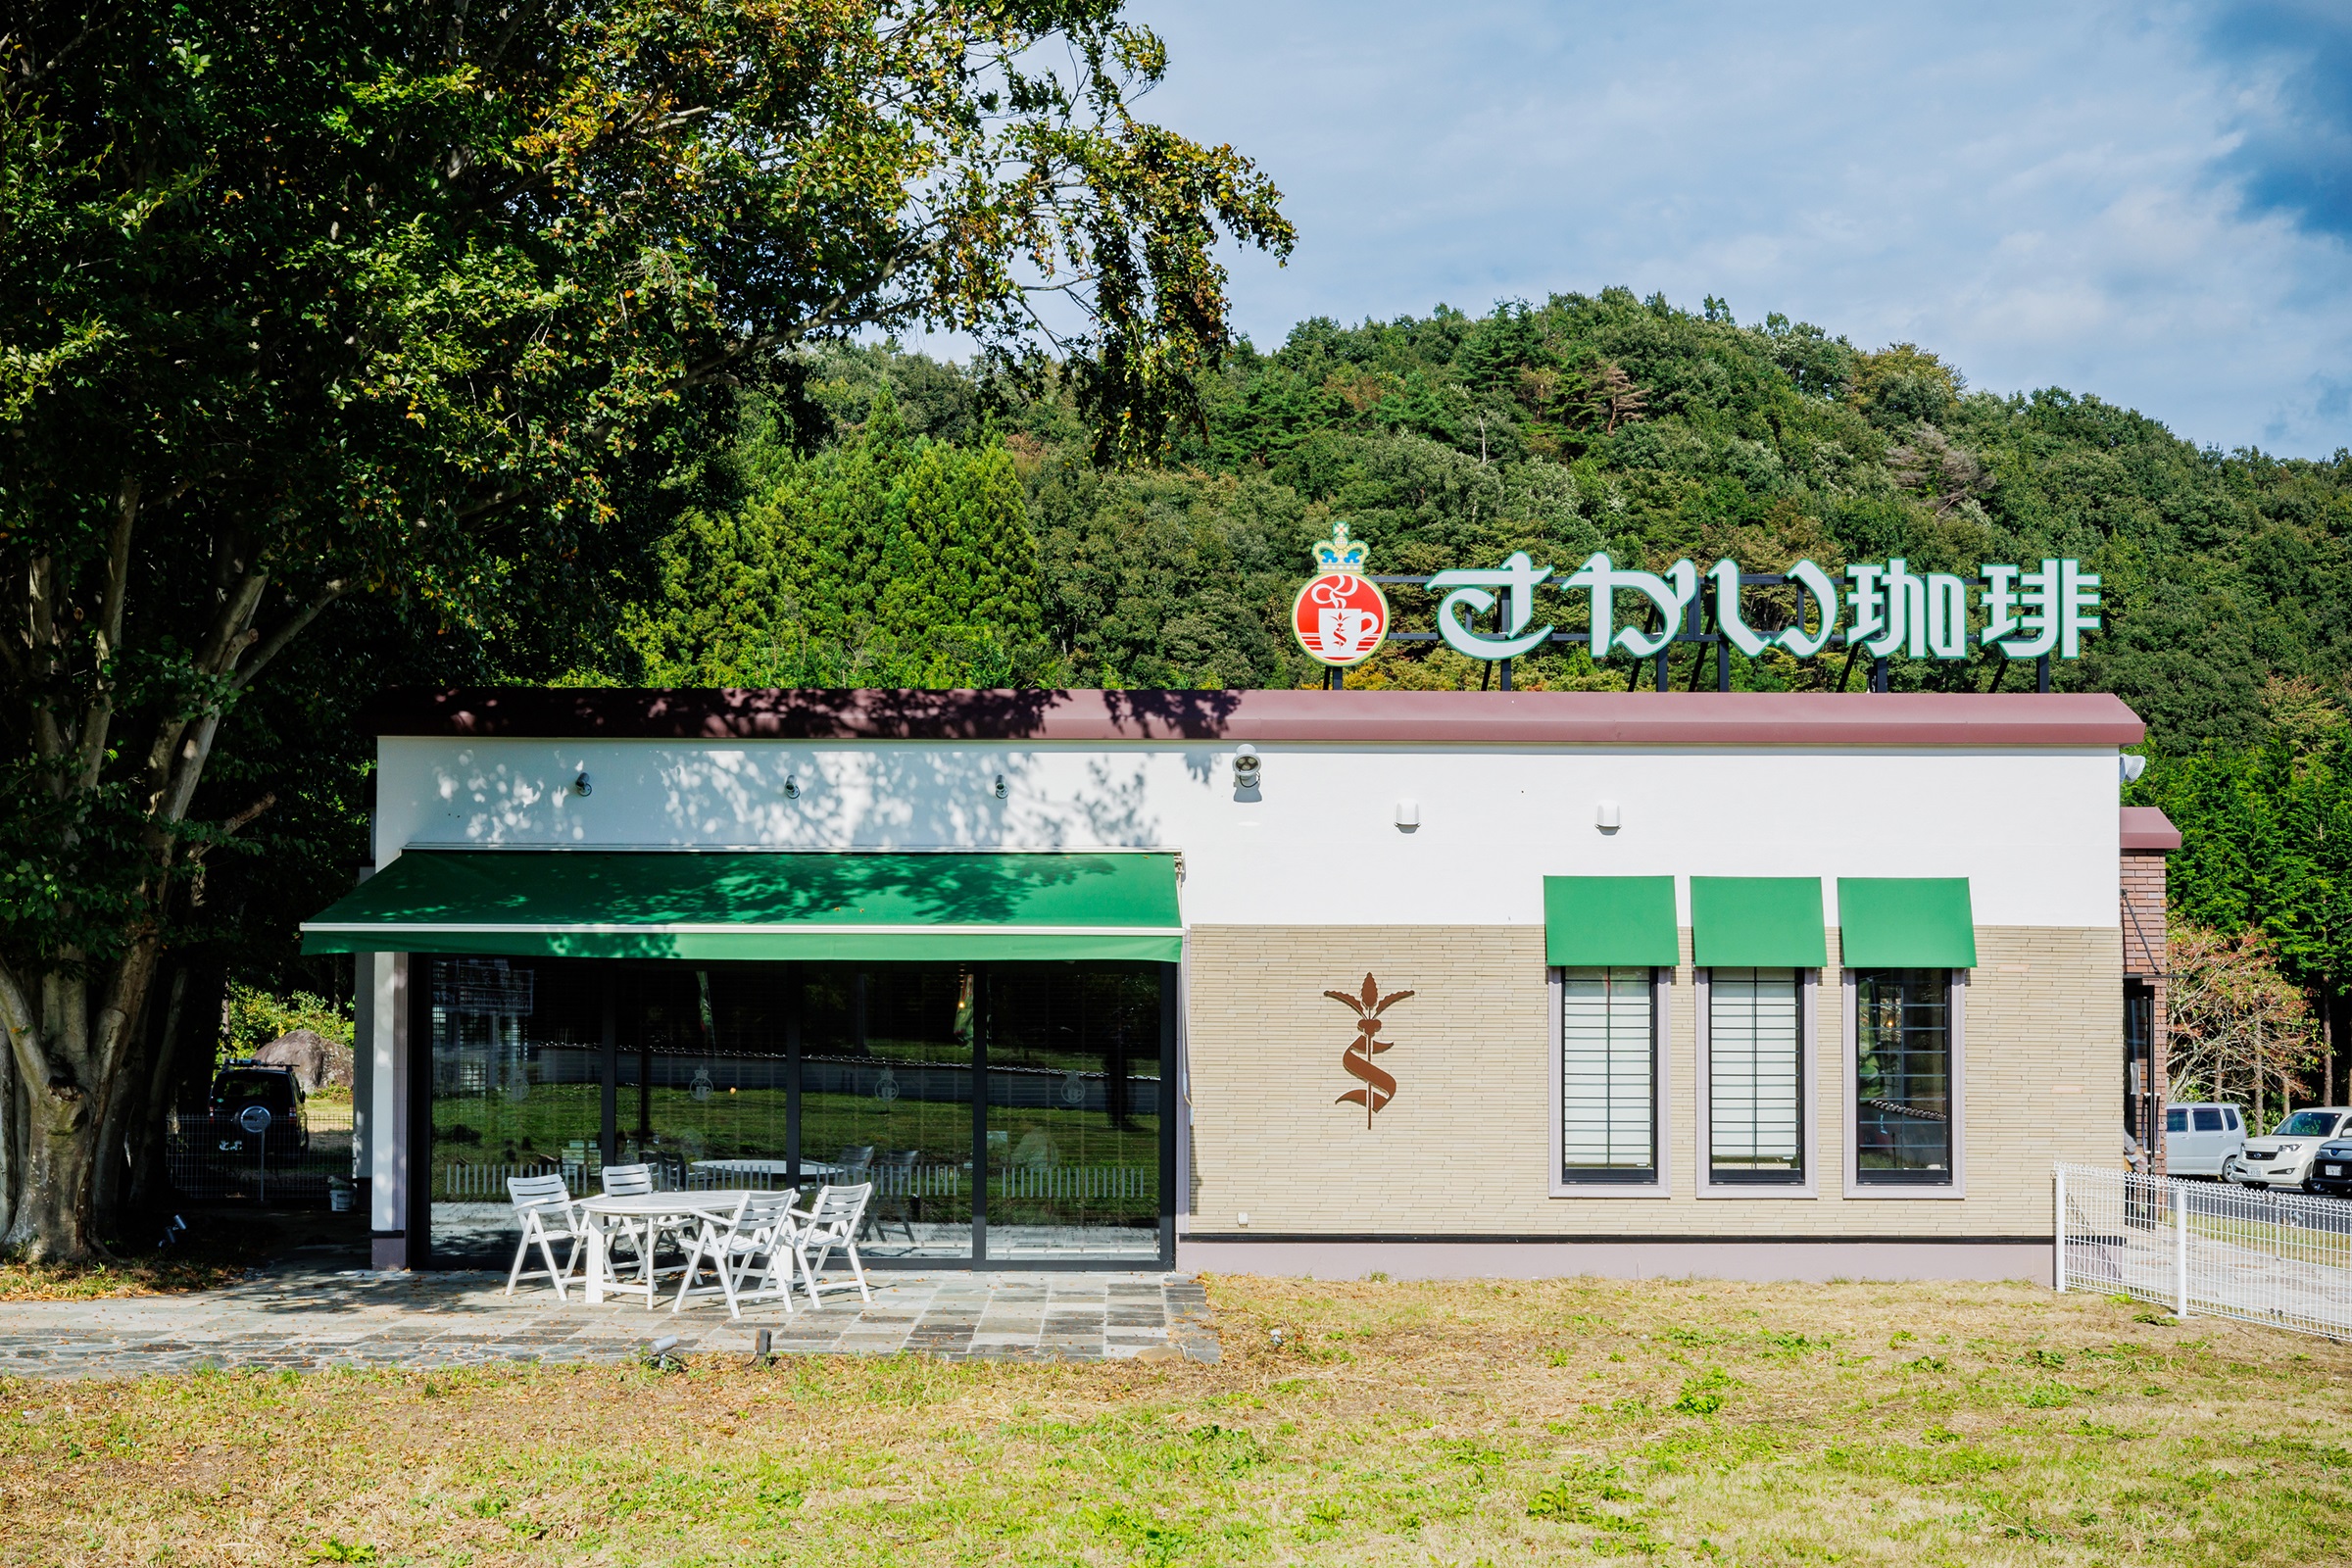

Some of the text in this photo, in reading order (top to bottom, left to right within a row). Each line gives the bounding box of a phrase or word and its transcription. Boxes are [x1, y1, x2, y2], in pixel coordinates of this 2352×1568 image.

[1426, 551, 2100, 661] さかい珈琲
